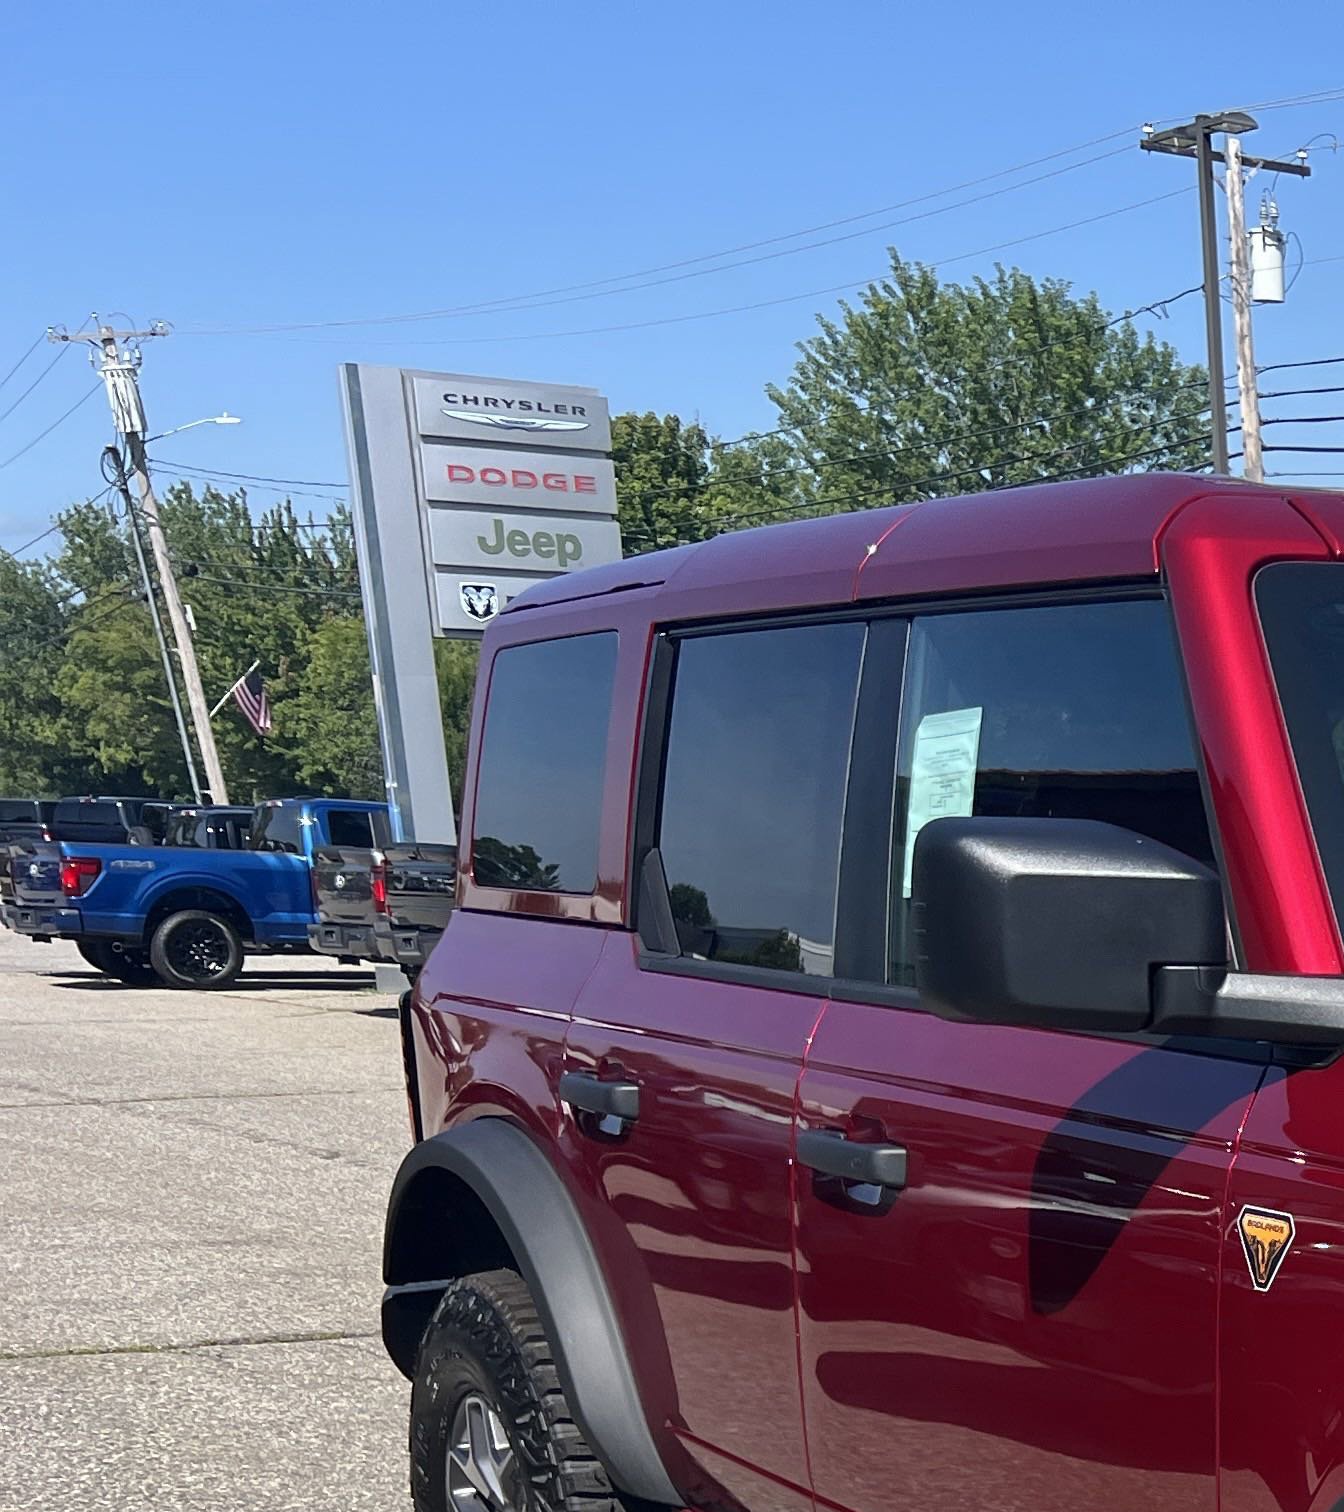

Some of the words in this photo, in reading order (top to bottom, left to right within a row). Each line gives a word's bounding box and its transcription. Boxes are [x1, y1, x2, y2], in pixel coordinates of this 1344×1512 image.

[442, 393, 587, 417] CHRYSLER
[447, 464, 598, 494] DODGE
[477, 518, 583, 567] Jeep
